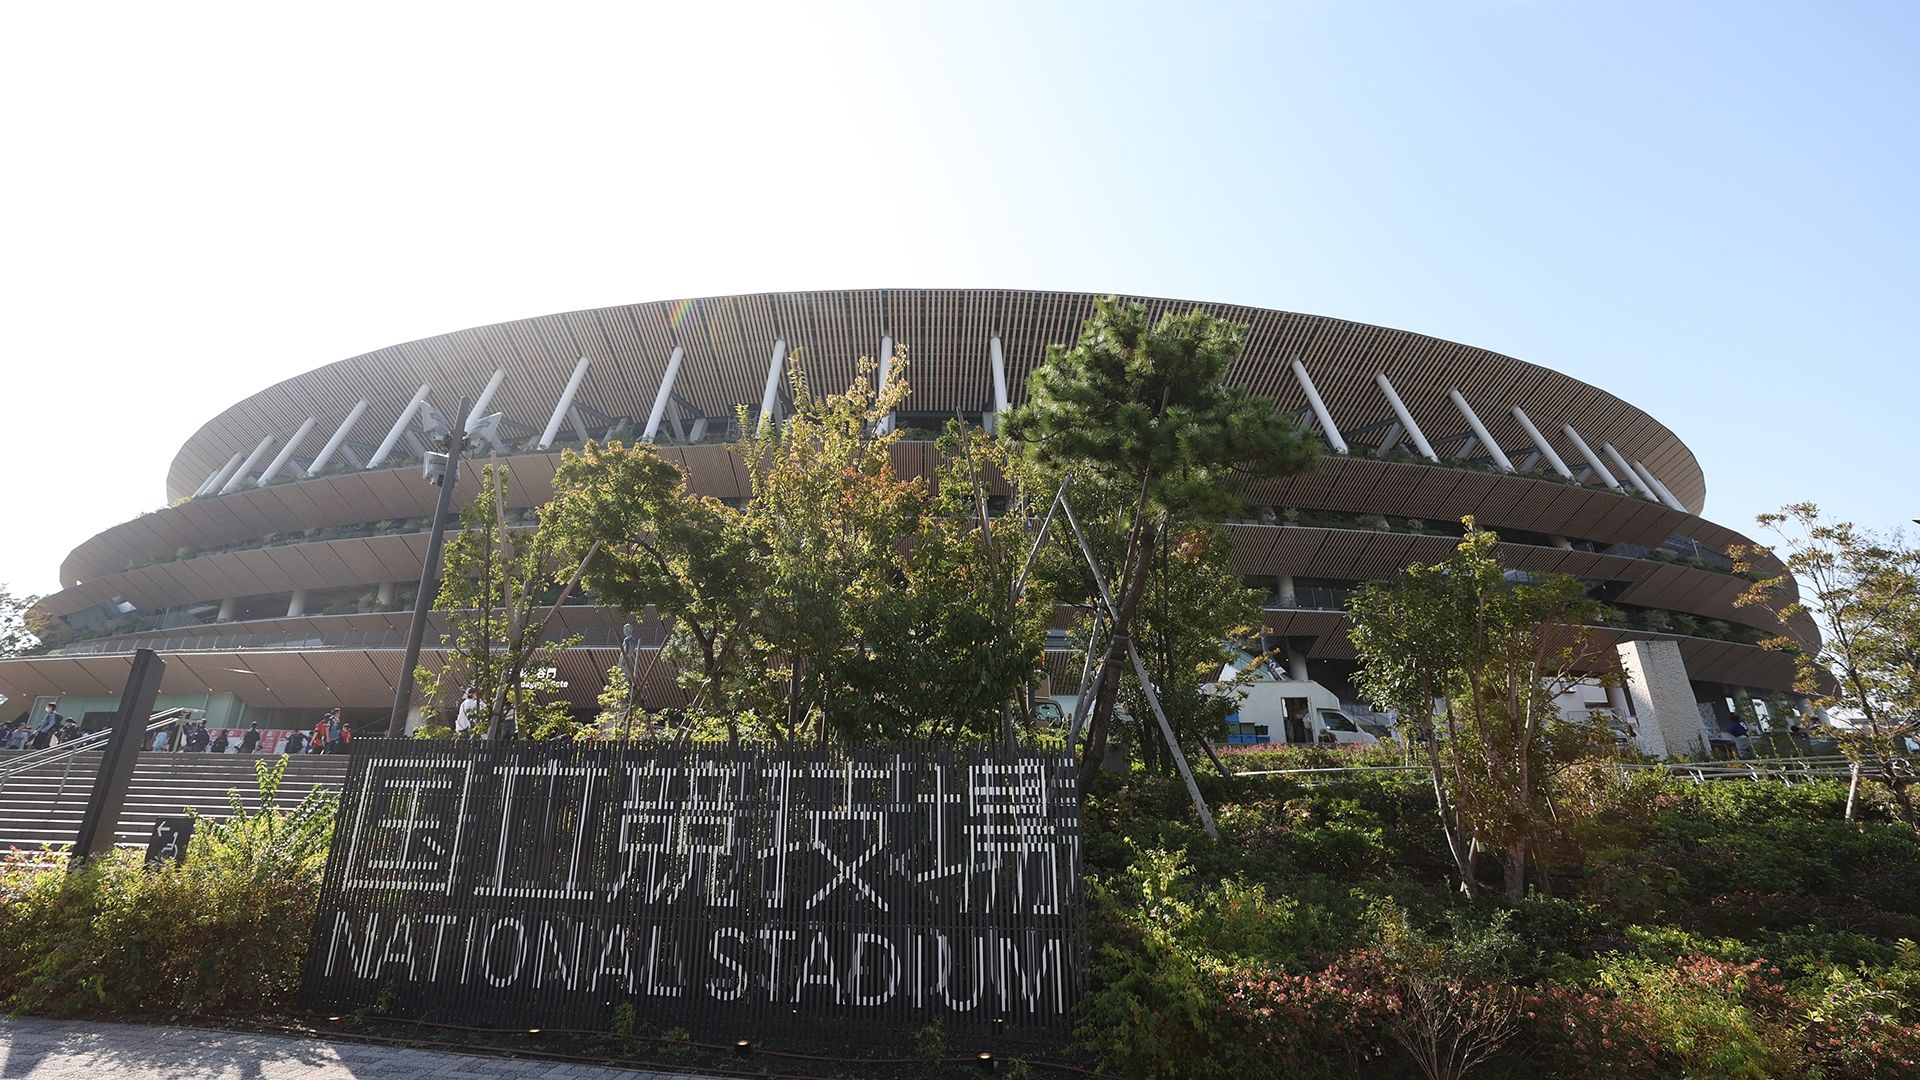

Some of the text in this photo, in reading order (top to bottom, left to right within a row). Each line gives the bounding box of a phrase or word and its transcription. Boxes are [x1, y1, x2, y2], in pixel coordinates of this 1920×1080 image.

[343, 757, 1073, 914] 国立競技場
[325, 911, 1063, 1014] NATIONAL STADIUM
